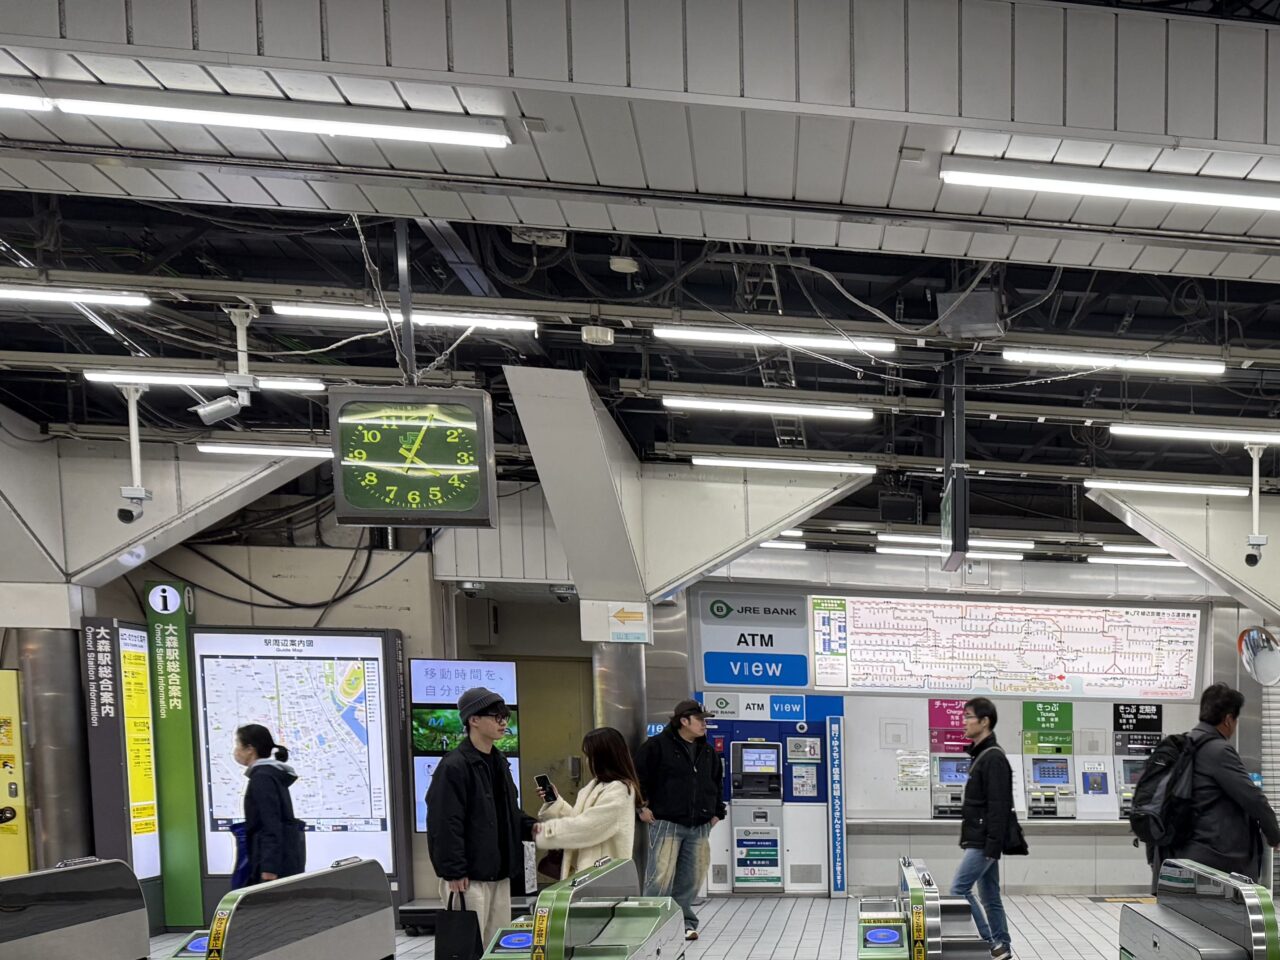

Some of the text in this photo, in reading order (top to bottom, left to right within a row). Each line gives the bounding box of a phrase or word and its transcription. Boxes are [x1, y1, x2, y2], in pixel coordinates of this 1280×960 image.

[362, 430, 381, 442] 10
[447, 430, 459, 442] 2
[354, 450, 367, 461] 9
[457, 452, 469, 465] 3
[365, 472, 378, 485] 8
[448, 474, 461, 487] 4
[386, 486, 398, 499] 7
[408, 491, 420, 503] 6
[429, 487, 441, 500] 5
[737, 606, 797, 616] JRE BANK
[737, 633, 774, 647] ATM
[96, 627, 114, 717] 大森駅総合案内
[154, 624, 166, 719] Omori Station Information
[164, 624, 181, 710] 大森駅総合案内
[86, 627, 98, 727] Omori Station Information
[424, 667, 504, 681] 移動時間を、
[745, 703, 765, 711] ATM
[1036, 703, 1059, 711] きっぷ
[1119, 705, 1157, 714] きっぷ 定期券
